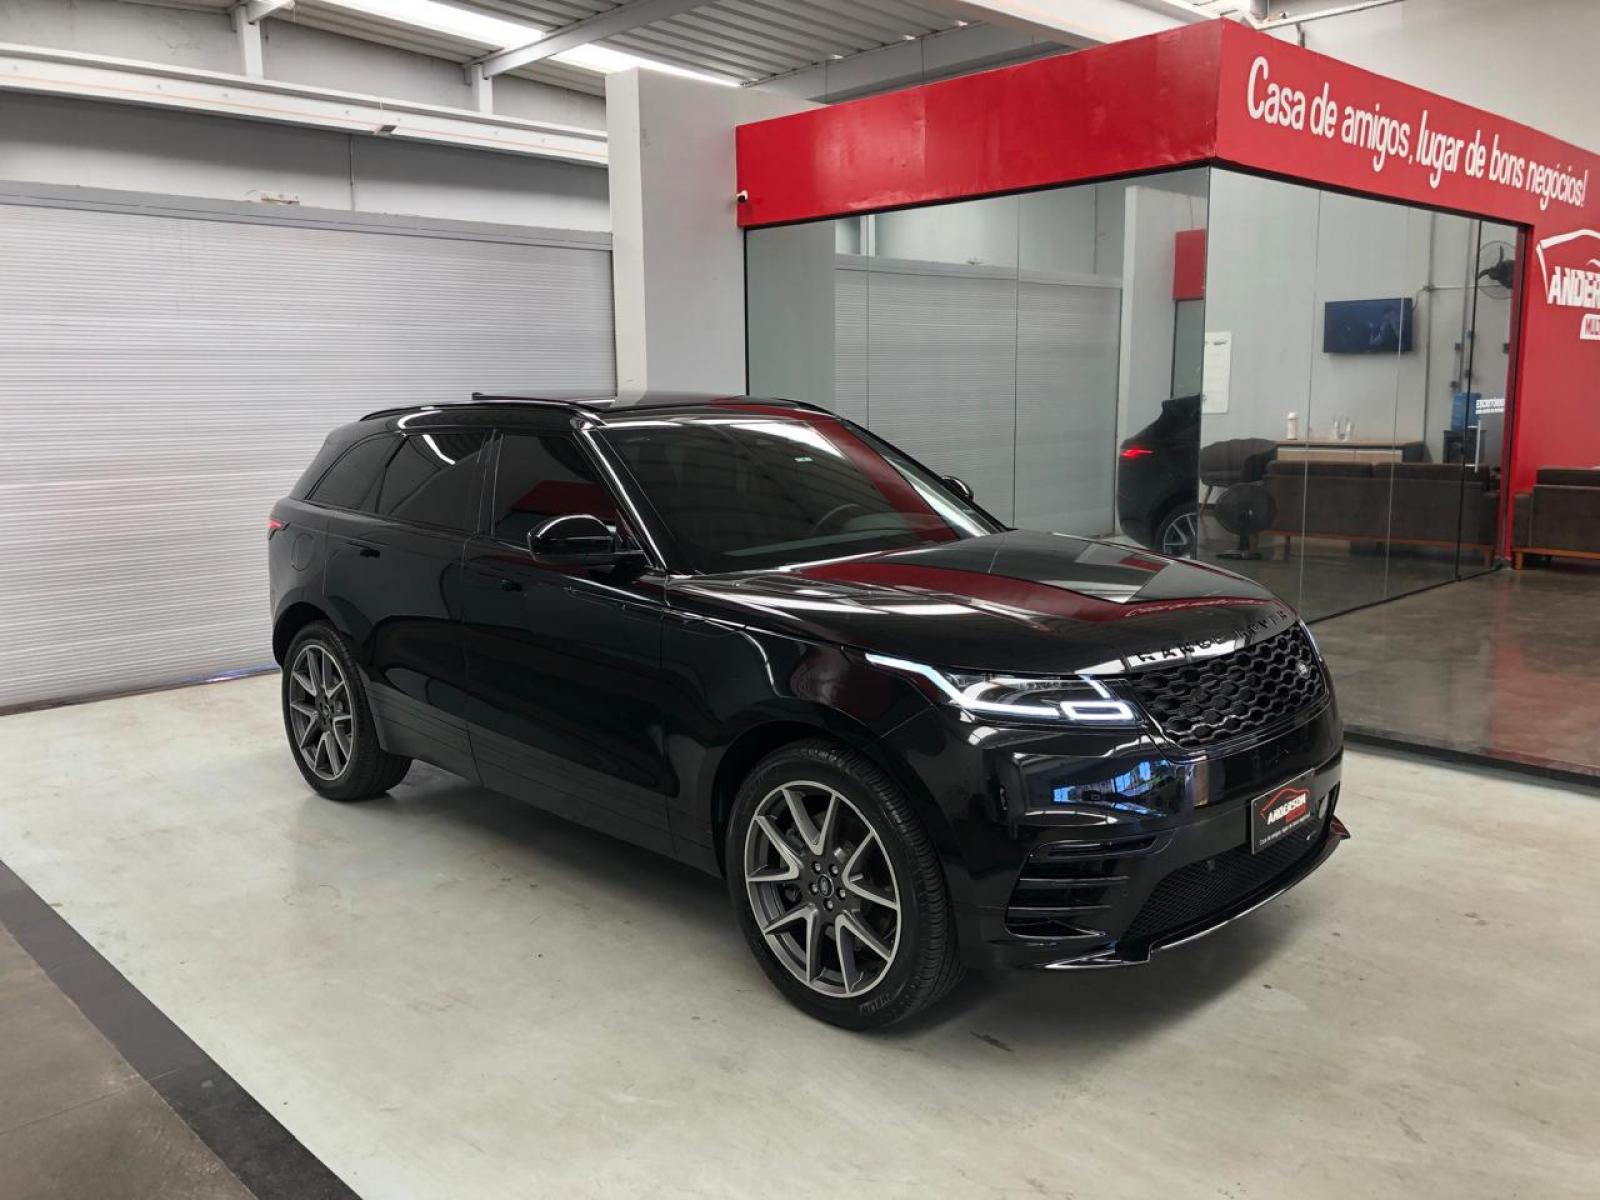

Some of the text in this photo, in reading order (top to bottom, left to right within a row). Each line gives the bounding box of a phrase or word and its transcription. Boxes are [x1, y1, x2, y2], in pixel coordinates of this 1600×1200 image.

[1247, 56, 1589, 211] Casa de amigos, lugar de bons negócios!
